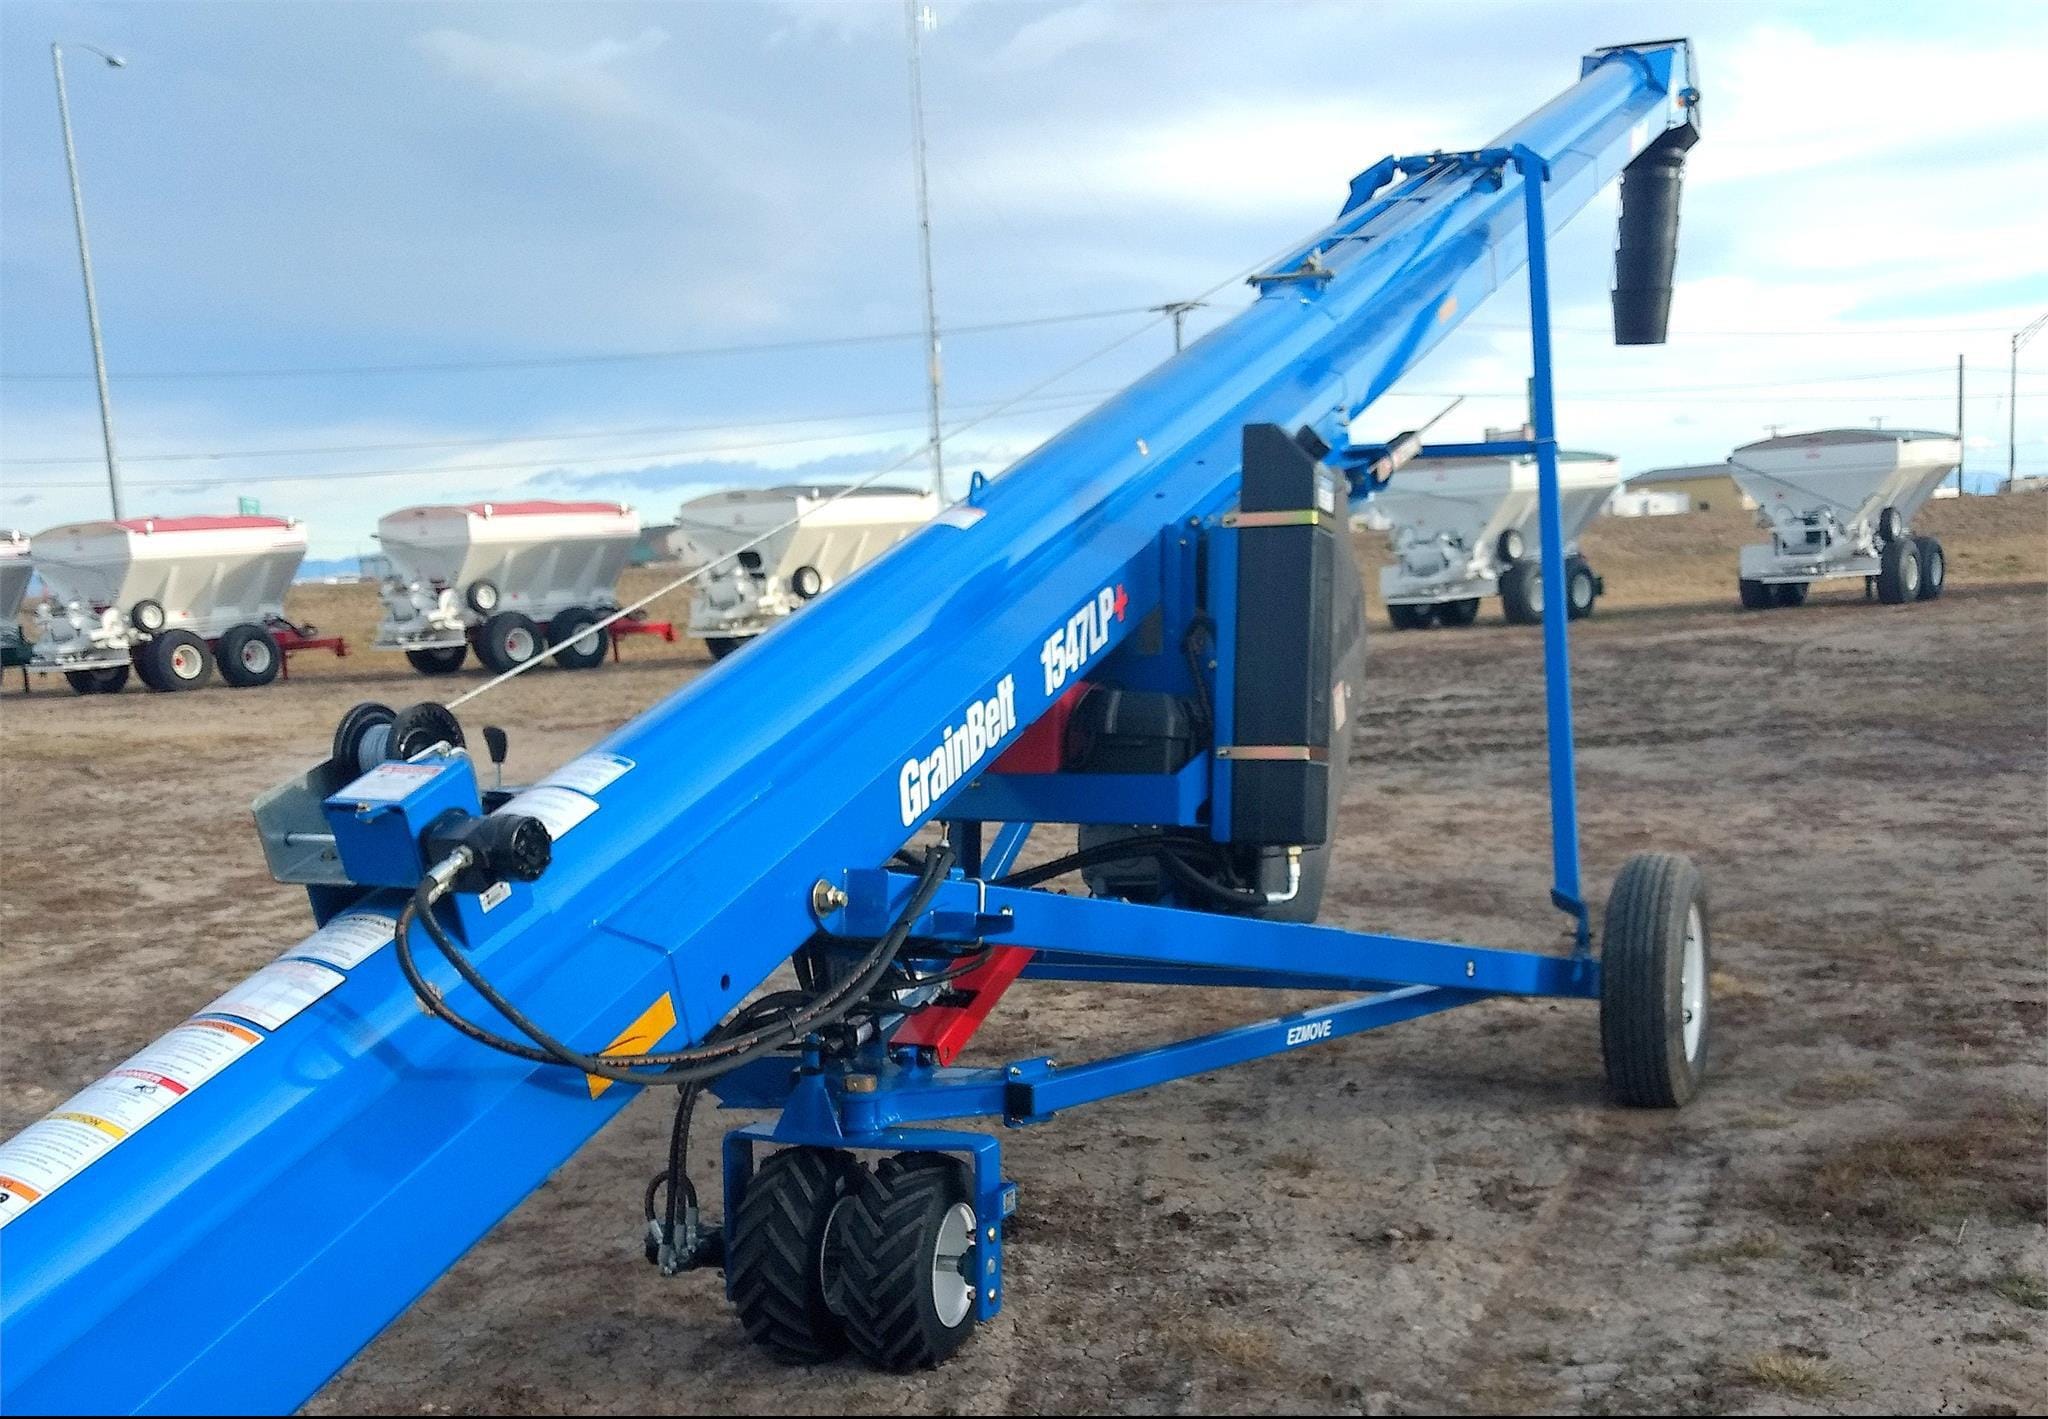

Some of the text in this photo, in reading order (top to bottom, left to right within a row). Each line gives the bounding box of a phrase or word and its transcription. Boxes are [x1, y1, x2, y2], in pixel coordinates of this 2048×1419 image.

[898, 583, 1129, 828] GrainBelt 1547LP+
[1286, 1019, 1334, 1046] EZMOVE
